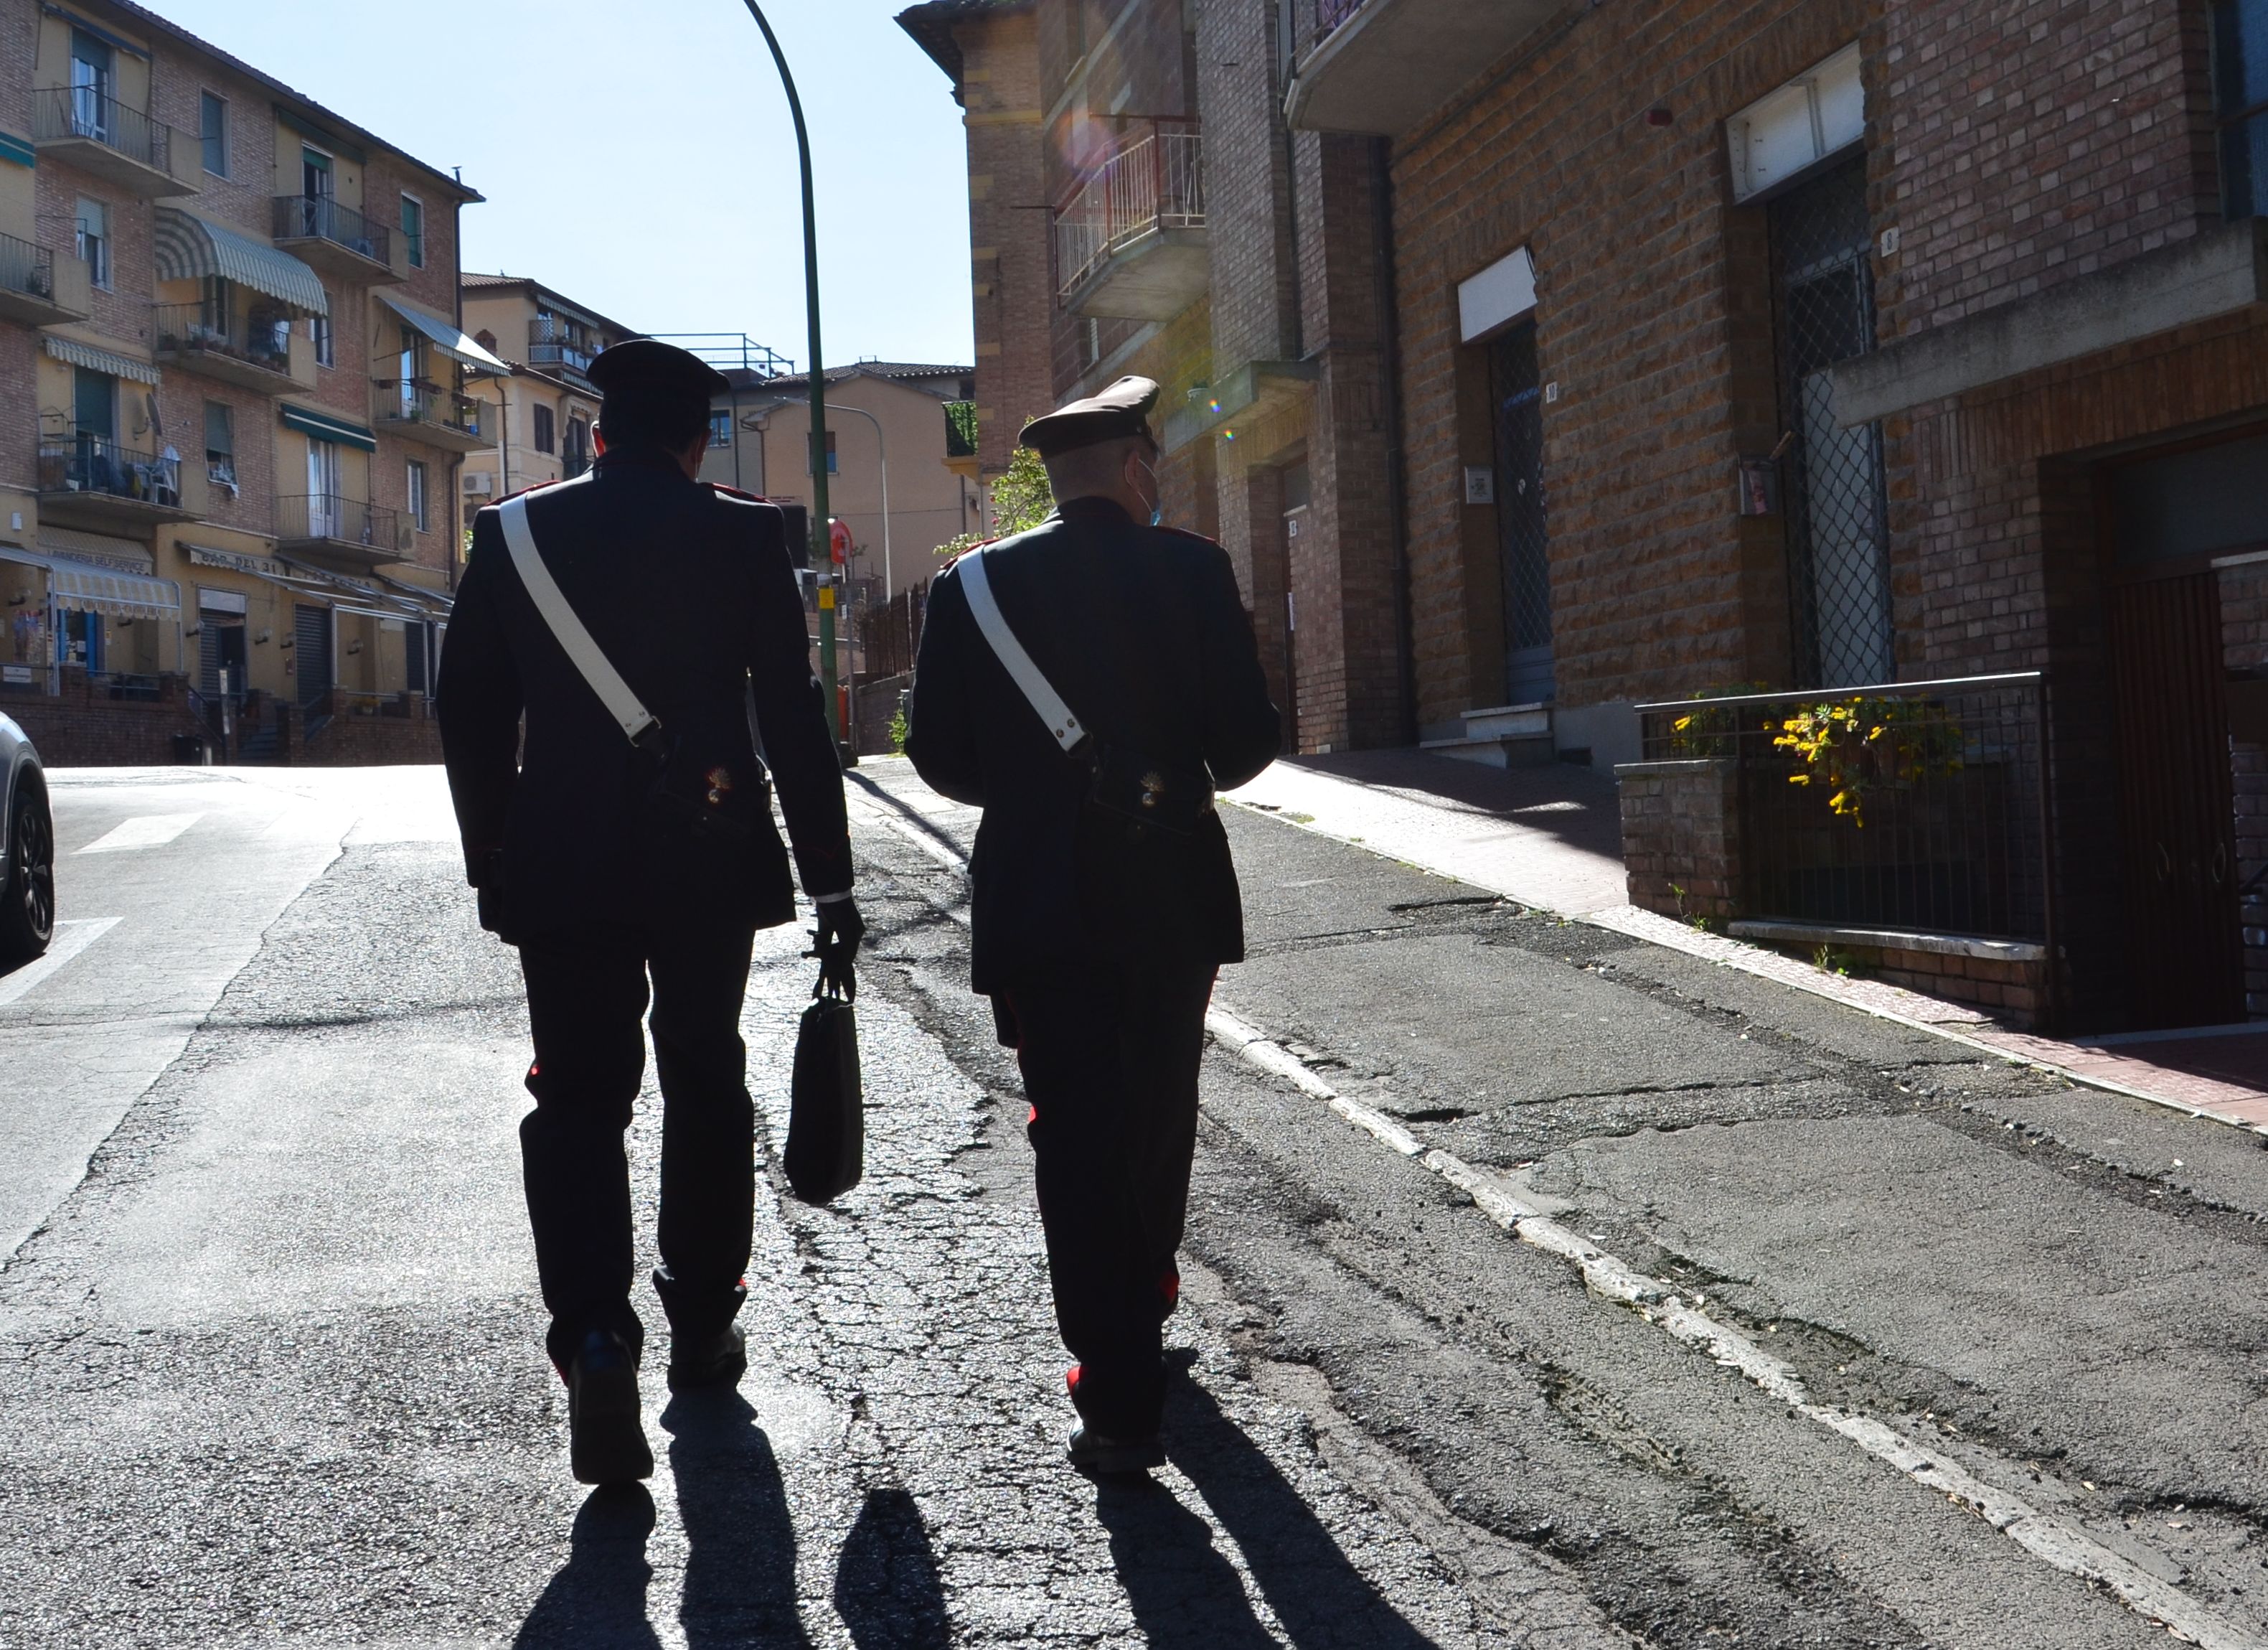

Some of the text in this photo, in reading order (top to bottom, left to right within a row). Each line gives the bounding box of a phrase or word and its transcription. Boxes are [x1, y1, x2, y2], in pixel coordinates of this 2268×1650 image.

[95, 556, 112, 567] SELF
[114, 560, 144, 571] SERVICE
[235, 556, 257, 569] DEL
[263, 562, 276, 573] 31
